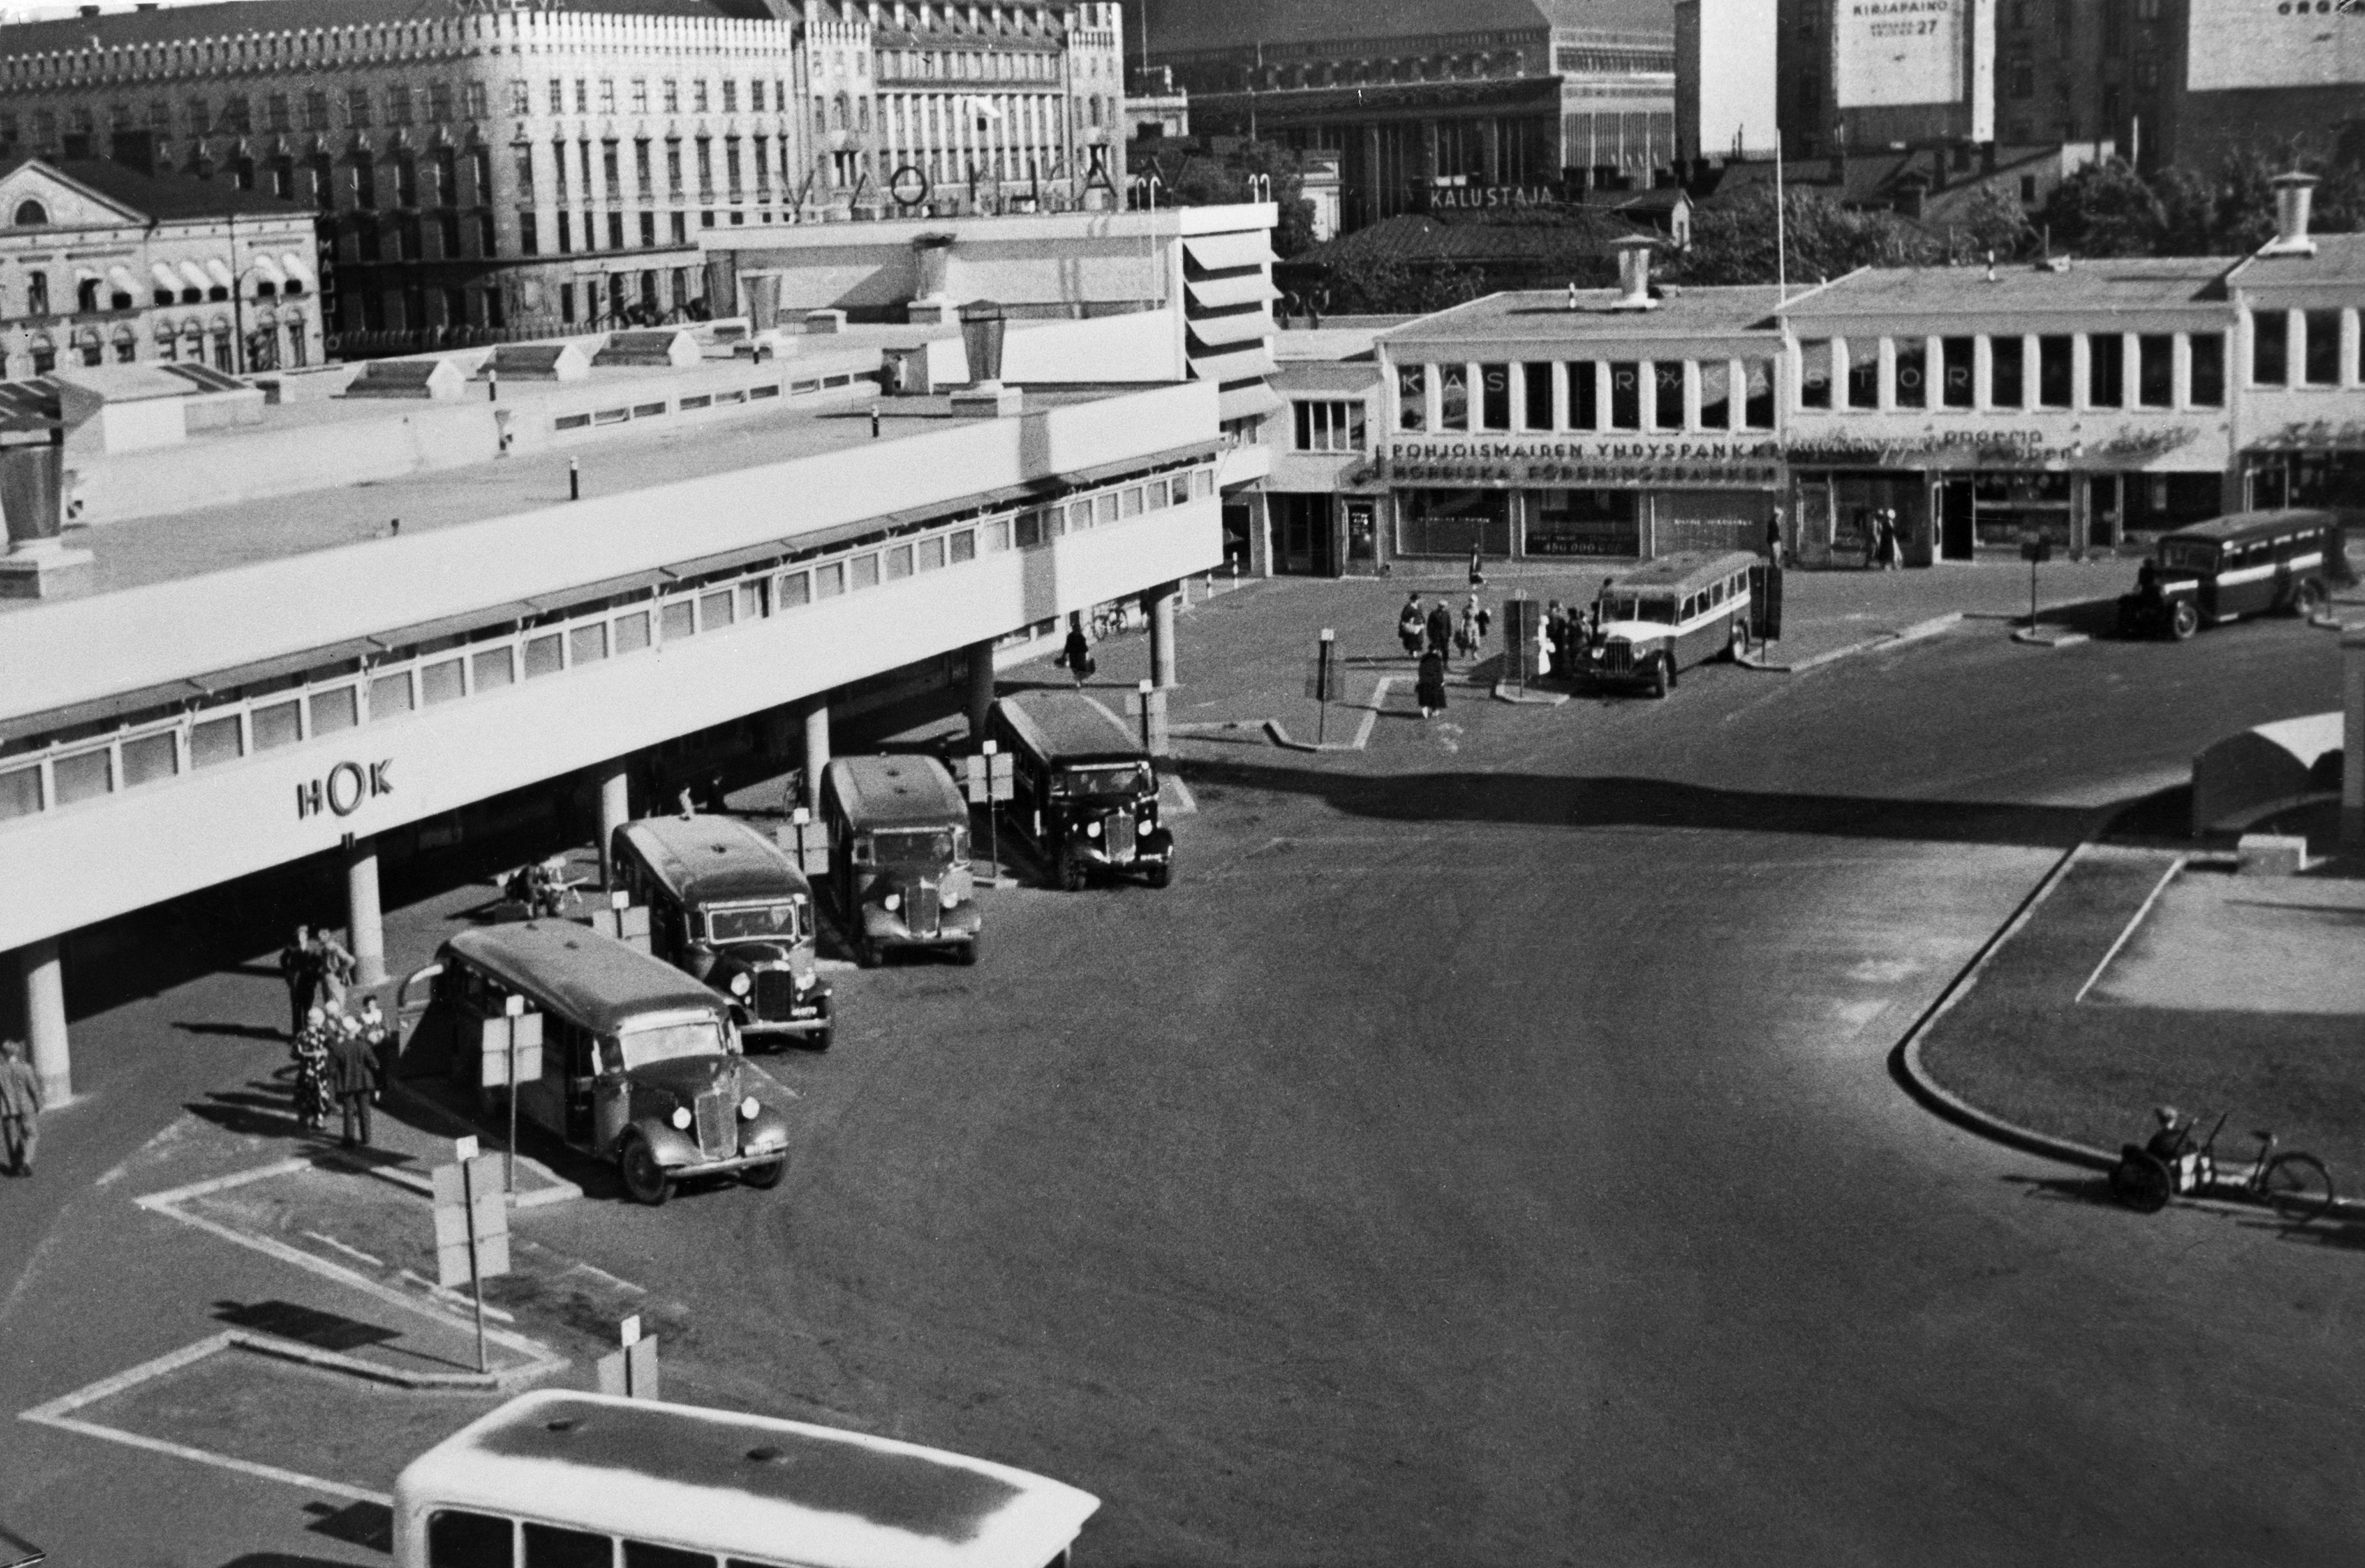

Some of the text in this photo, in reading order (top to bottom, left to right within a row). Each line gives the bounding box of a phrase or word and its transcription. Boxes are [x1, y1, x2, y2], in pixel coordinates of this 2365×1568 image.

[1917, 19, 1938, 35] 27
[1430, 187, 1554, 208] KALUSTAJA
[1392, 443, 1778, 459] POHJOISMAIDEN YHDYSPANKKI
[297, 758, 394, 820] HOK
